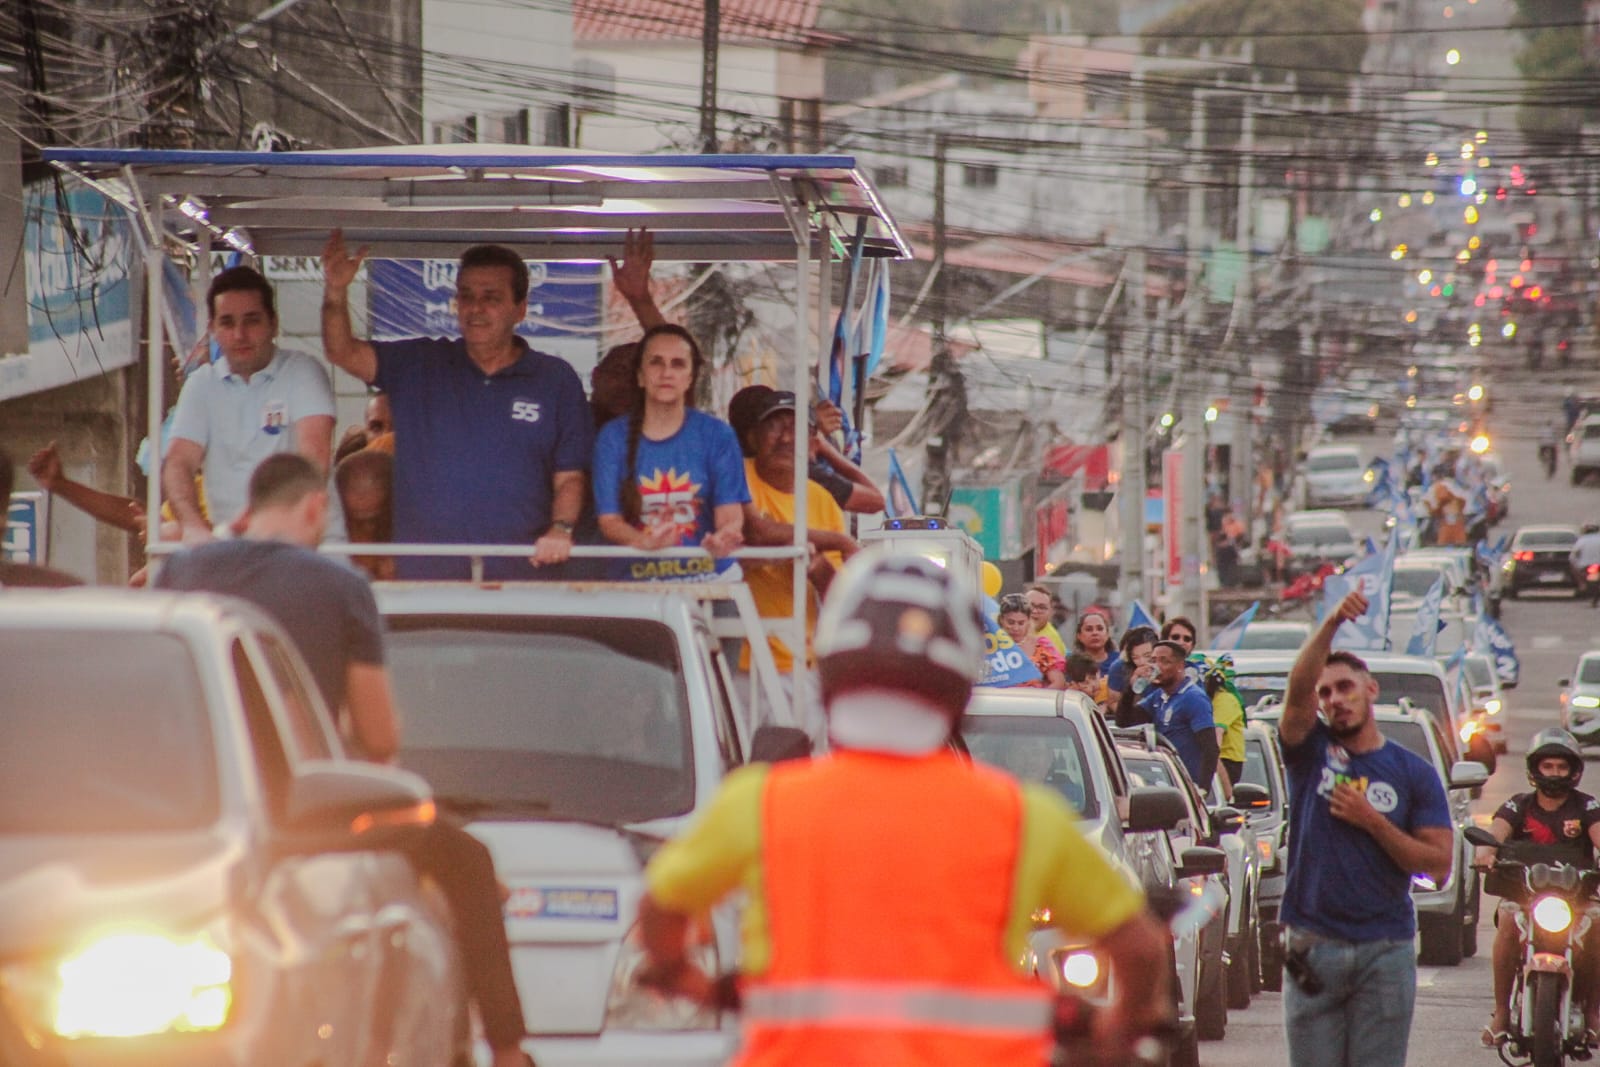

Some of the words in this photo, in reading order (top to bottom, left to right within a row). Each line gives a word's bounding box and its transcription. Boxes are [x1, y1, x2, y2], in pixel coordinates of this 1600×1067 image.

[511, 401, 540, 422] 55
[641, 491, 696, 525] 55
[631, 556, 715, 579] CARLOS
[1372, 788, 1392, 806] 55
